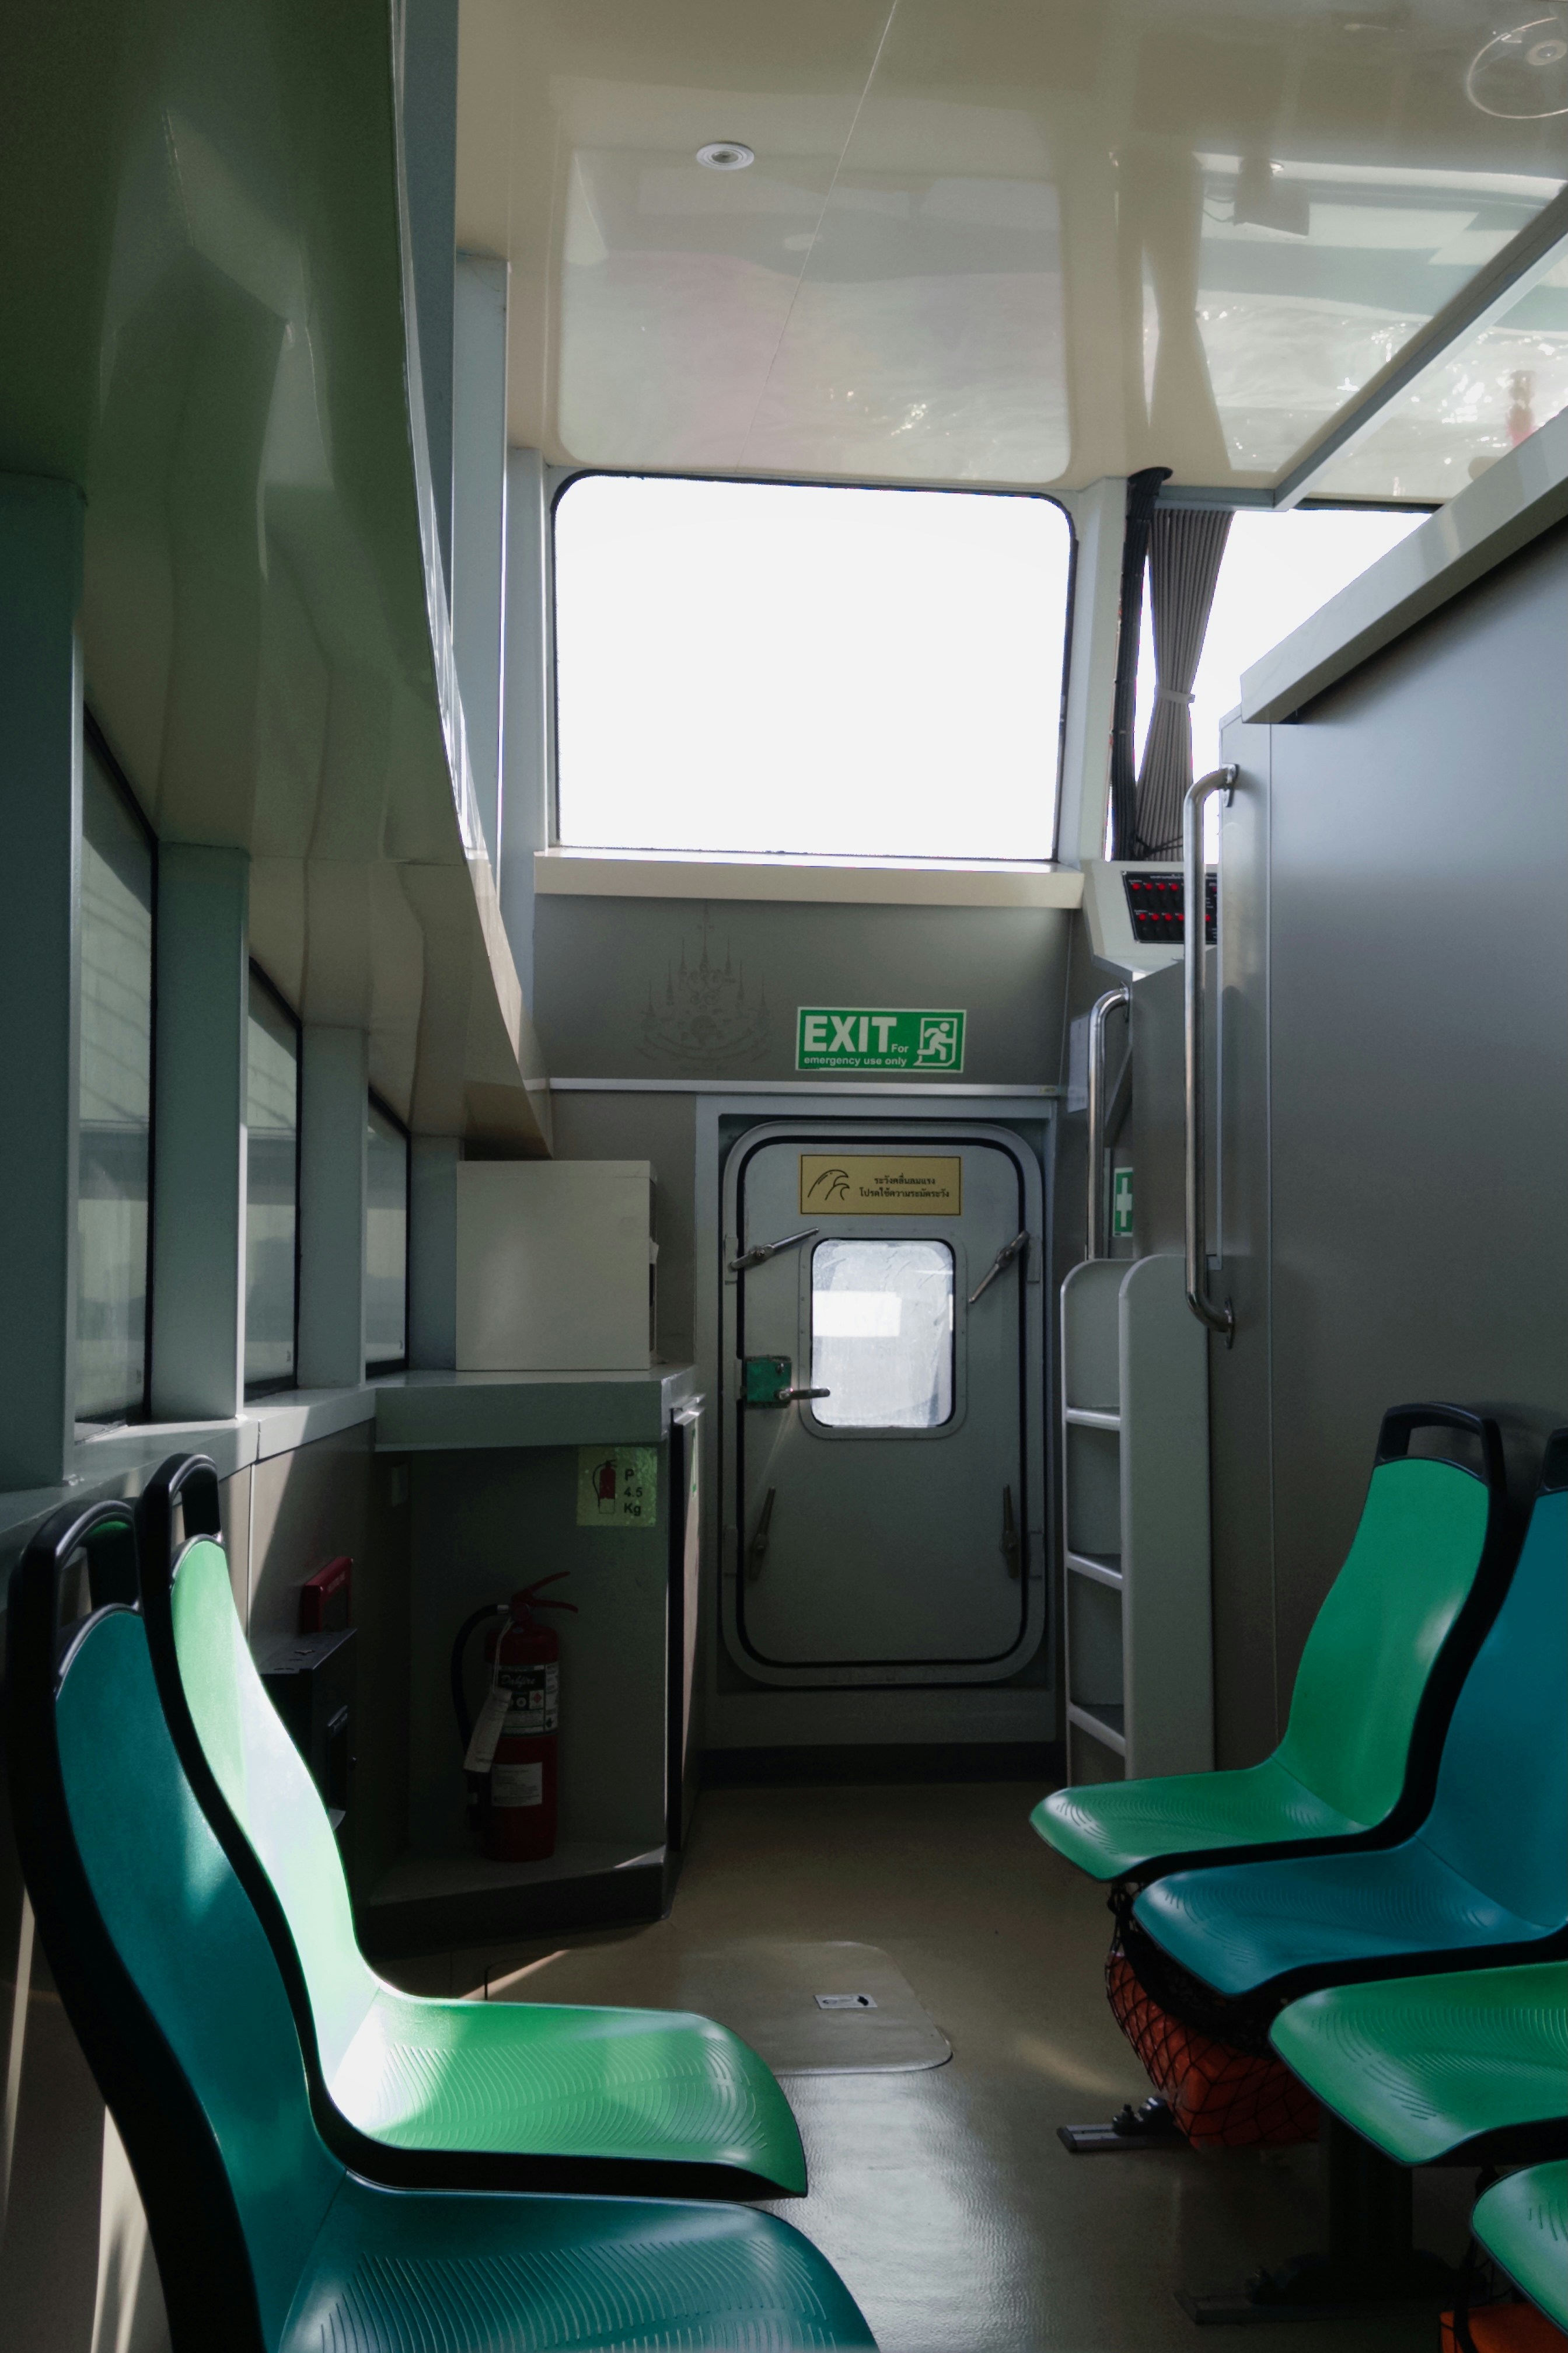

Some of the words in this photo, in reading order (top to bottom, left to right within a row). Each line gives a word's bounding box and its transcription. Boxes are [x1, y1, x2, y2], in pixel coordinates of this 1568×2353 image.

[804, 1015, 897, 1053] EXIT
[891, 1043, 909, 1053] For
[804, 1057, 861, 1066] emergency
[885, 1057, 907, 1067] only
[874, 1172, 935, 1185] ระวังคลื่นลมแรง
[860, 1187, 949, 1198] โปรดใช้ความระมัดระวัง
[625, 1469, 634, 1481] P
[624, 1487, 642, 1497] 4.5
[624, 1503, 641, 1516] Kg
